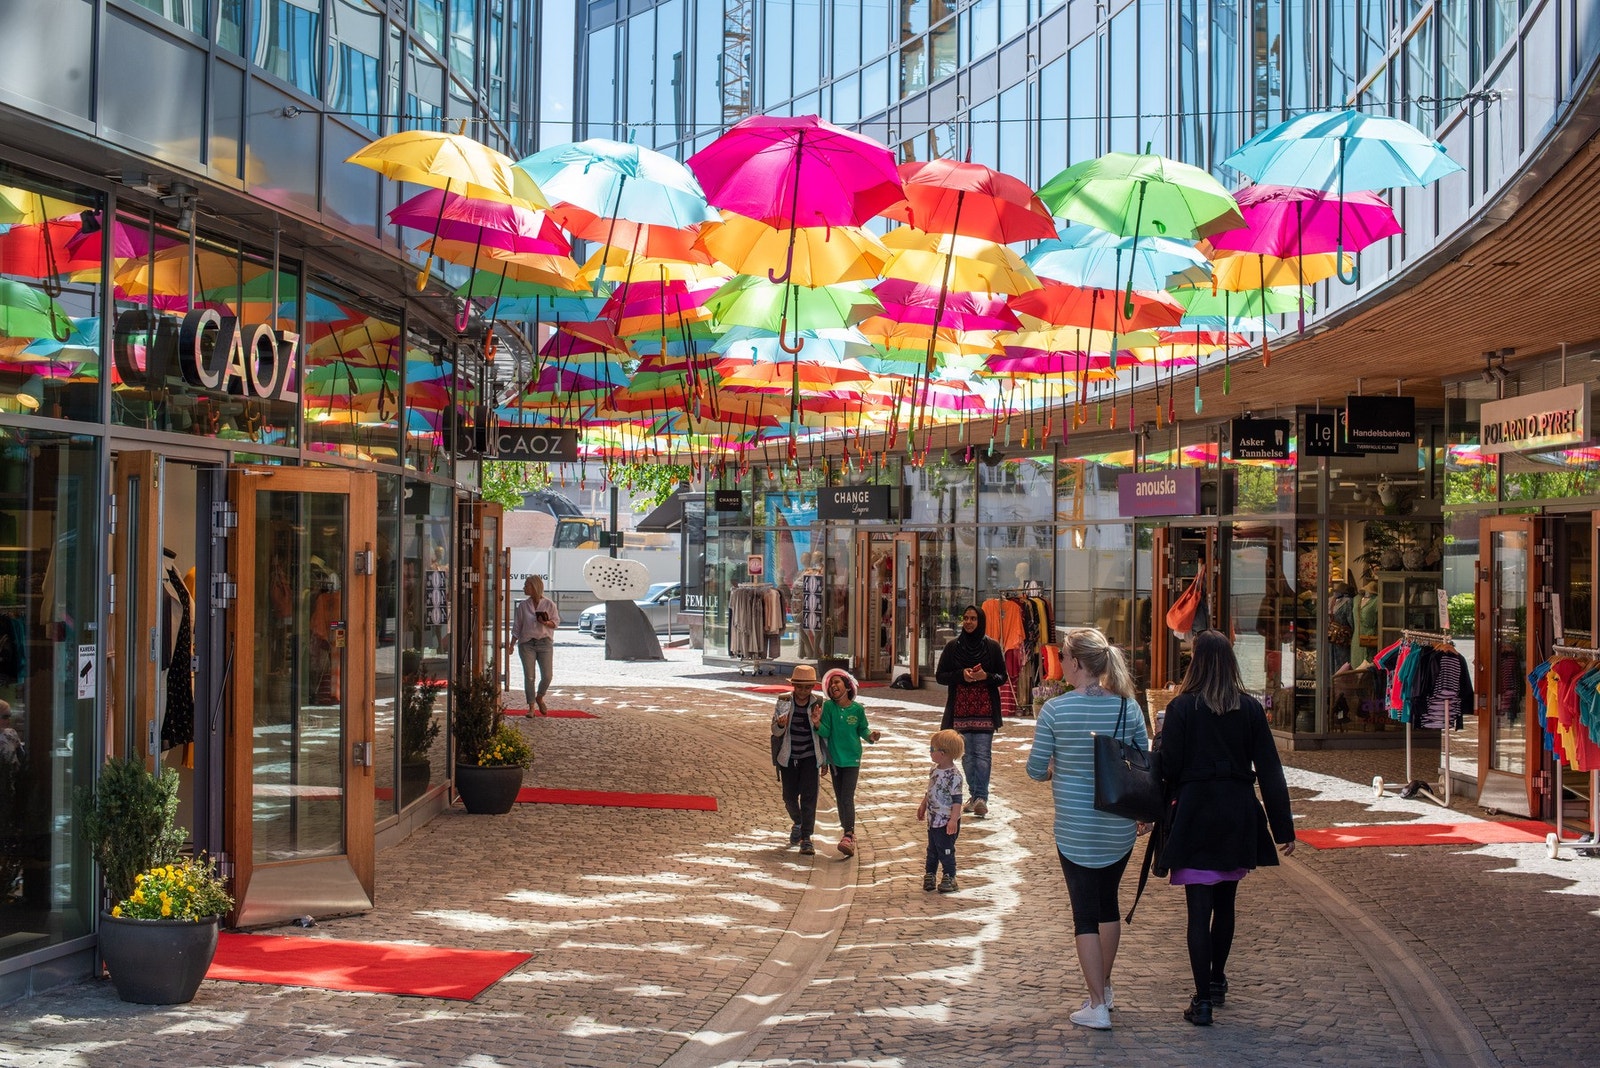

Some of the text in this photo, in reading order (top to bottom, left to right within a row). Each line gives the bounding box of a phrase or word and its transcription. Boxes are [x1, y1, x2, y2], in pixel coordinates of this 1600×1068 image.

[194, 308, 299, 403] CAOZ
[1352, 429, 1411, 438] Handelsbanken
[1484, 418, 1526, 445] POLARN
[1541, 409, 1577, 437] PYRET
[498, 434, 563, 454] CAOZ
[1239, 438, 1265, 447] Asker
[1239, 449, 1284, 458] Tannhelse
[1135, 474, 1177, 496] anouska
[834, 491, 869, 504] CHANGE
